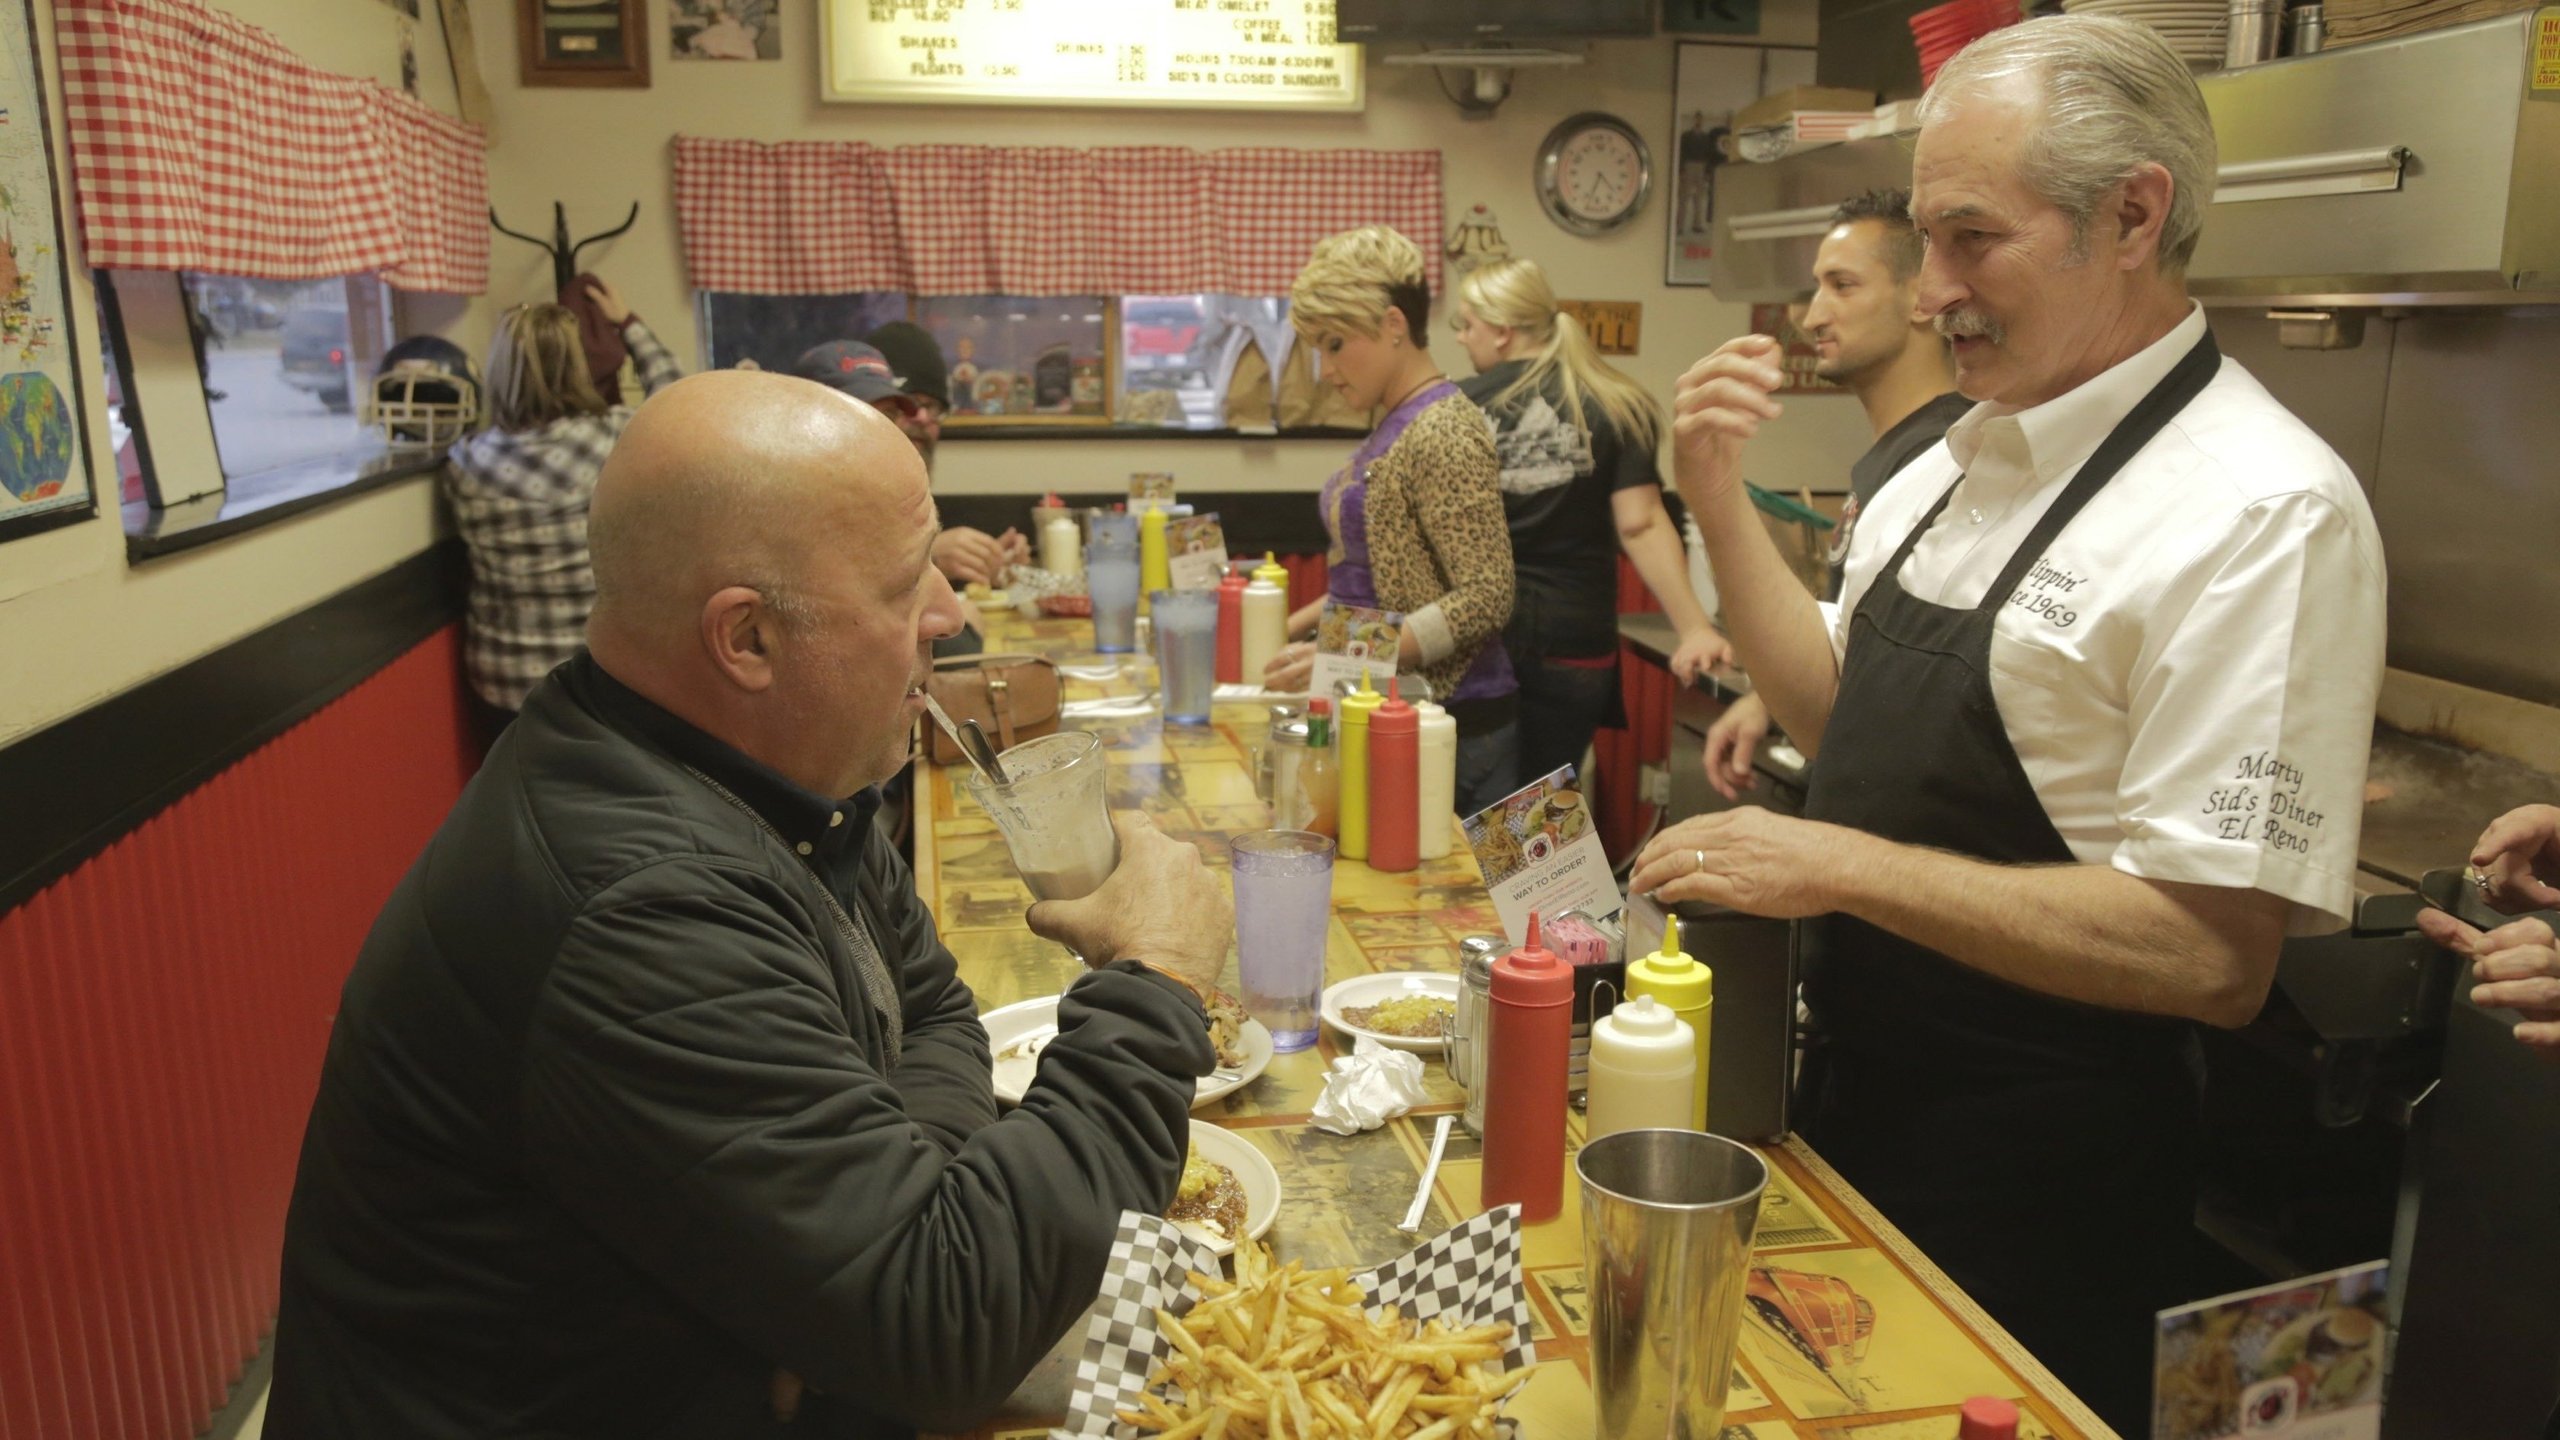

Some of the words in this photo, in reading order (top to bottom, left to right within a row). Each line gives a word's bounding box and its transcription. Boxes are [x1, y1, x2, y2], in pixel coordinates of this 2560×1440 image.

[1233, 18, 1280, 31] COFFEE
[899, 36, 957, 48] SHAKES
[1260, 33, 1293, 44] MEAL
[1175, 54, 1220, 65] HOURS
[911, 62, 964, 75] FLOATS
[1168, 71, 1200, 82] SID'S
[1207, 72, 1217, 83] IS
[1223, 73, 1276, 85] CLOSED
[1282, 74, 1341, 87] SUNDAYS
[2024, 594, 2077, 628] 1969
[2235, 750, 2304, 795] Marty
[2203, 786, 2259, 815] Sid's
[2270, 792, 2325, 829] Diner
[2219, 815, 2256, 840] El
[2262, 819, 2309, 854] Reno
[1512, 885, 1535, 902] WAY
[1535, 876, 1549, 889] TO
[1550, 855, 1587, 880] ORDER?
